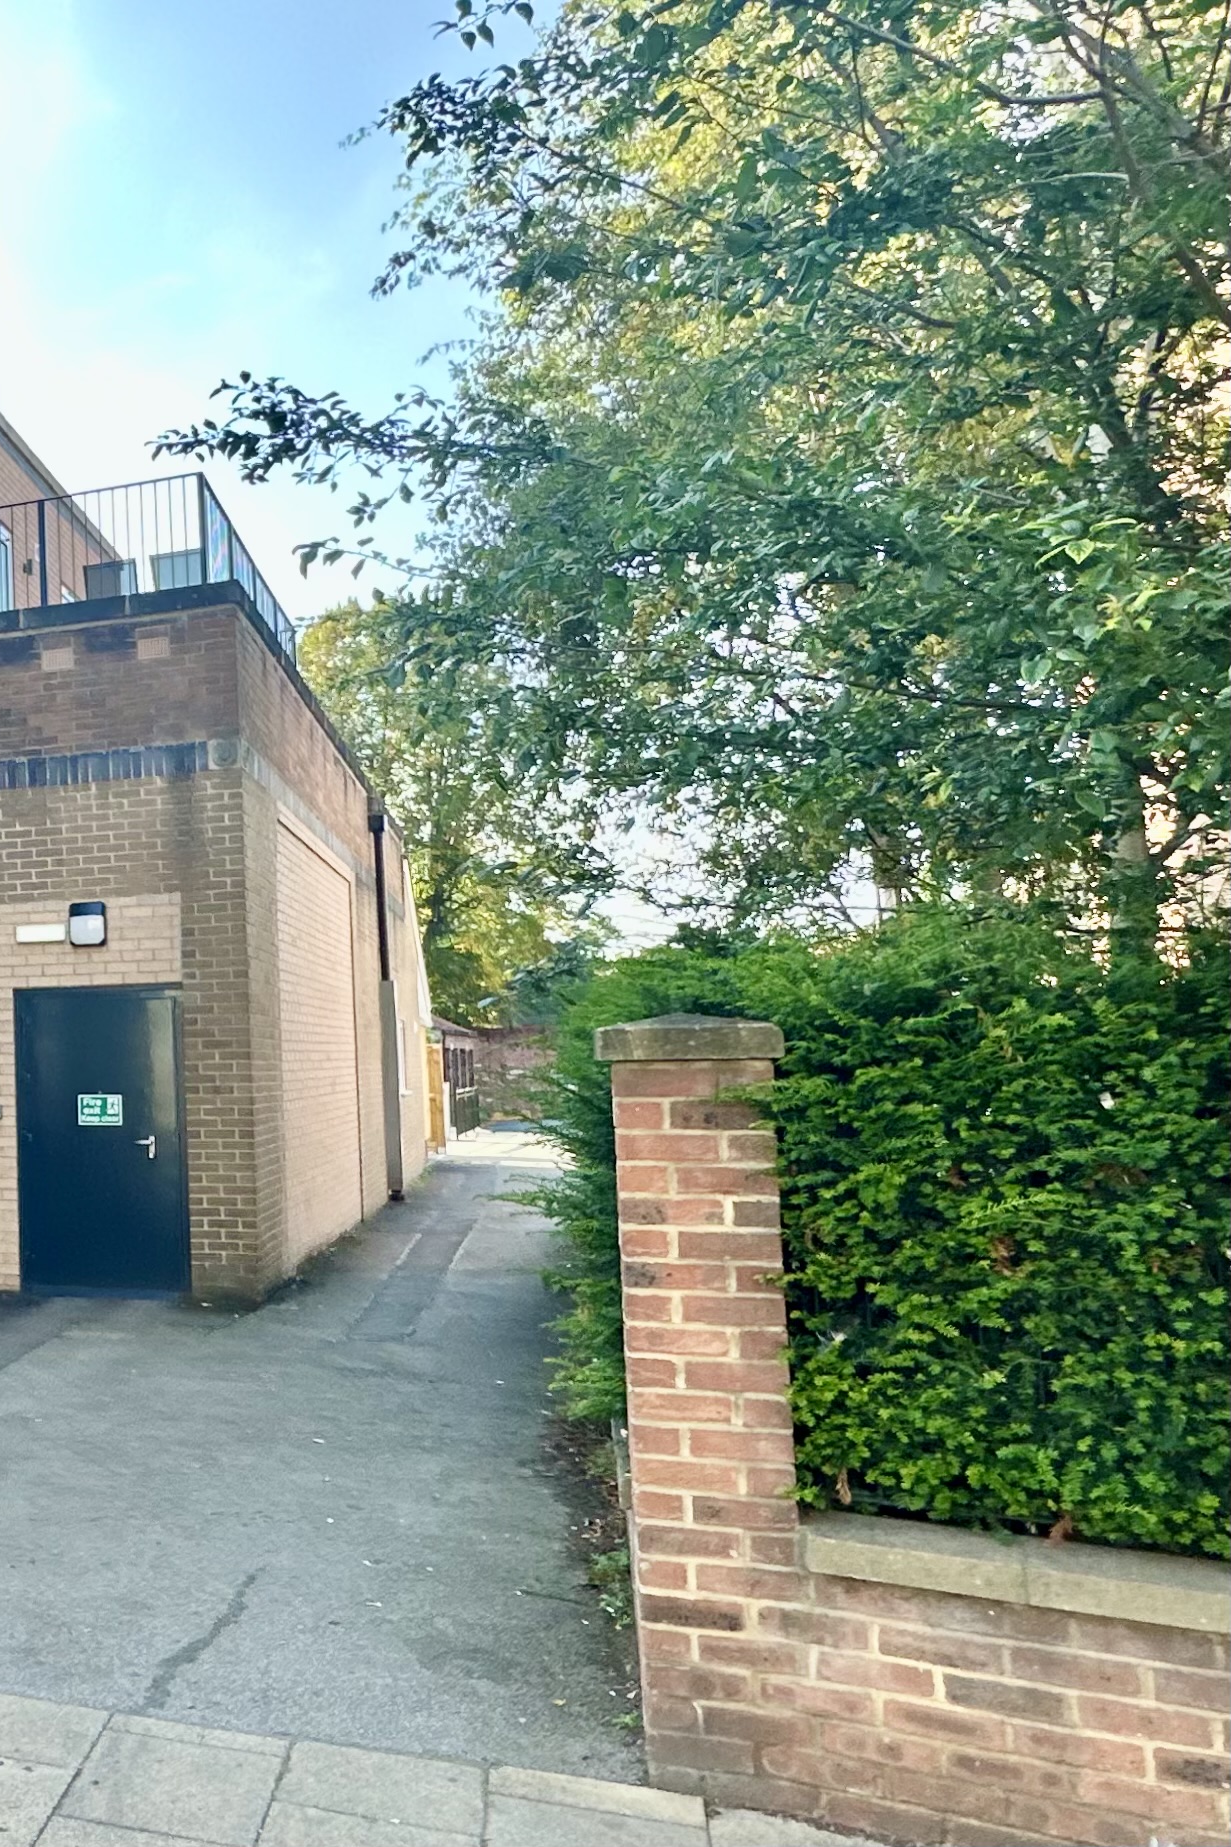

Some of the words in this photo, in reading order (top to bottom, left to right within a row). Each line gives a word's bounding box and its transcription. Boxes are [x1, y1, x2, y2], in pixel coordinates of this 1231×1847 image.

[83, 1098, 102, 1106] Fire
[83, 1106, 101, 1114] exit
[81, 1115, 100, 1123] Keep
